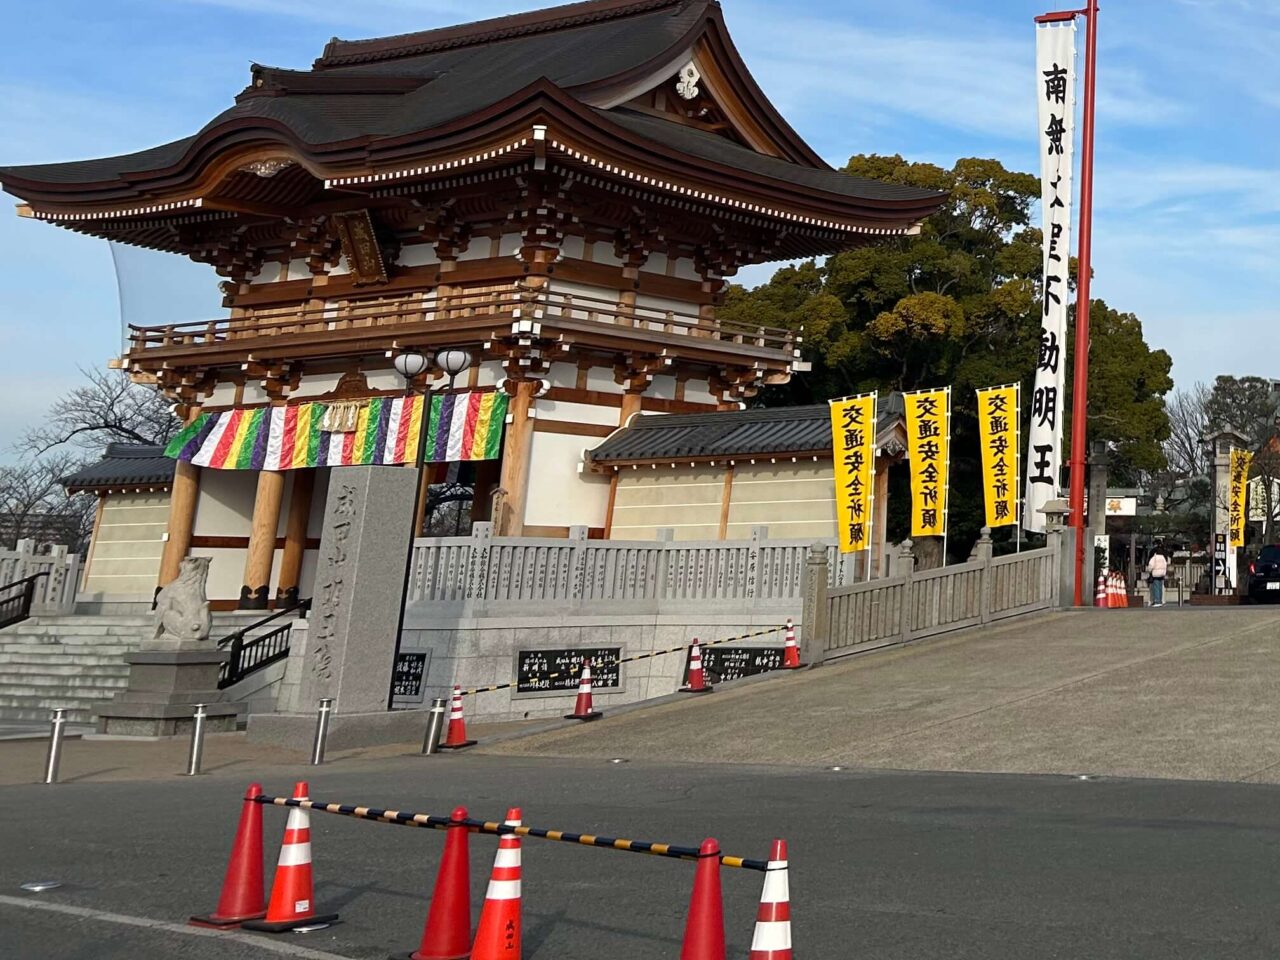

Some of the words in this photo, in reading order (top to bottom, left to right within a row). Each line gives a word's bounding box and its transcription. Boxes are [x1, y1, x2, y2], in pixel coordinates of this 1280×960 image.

[1230, 455, 1247, 542] 交通安全祈願
